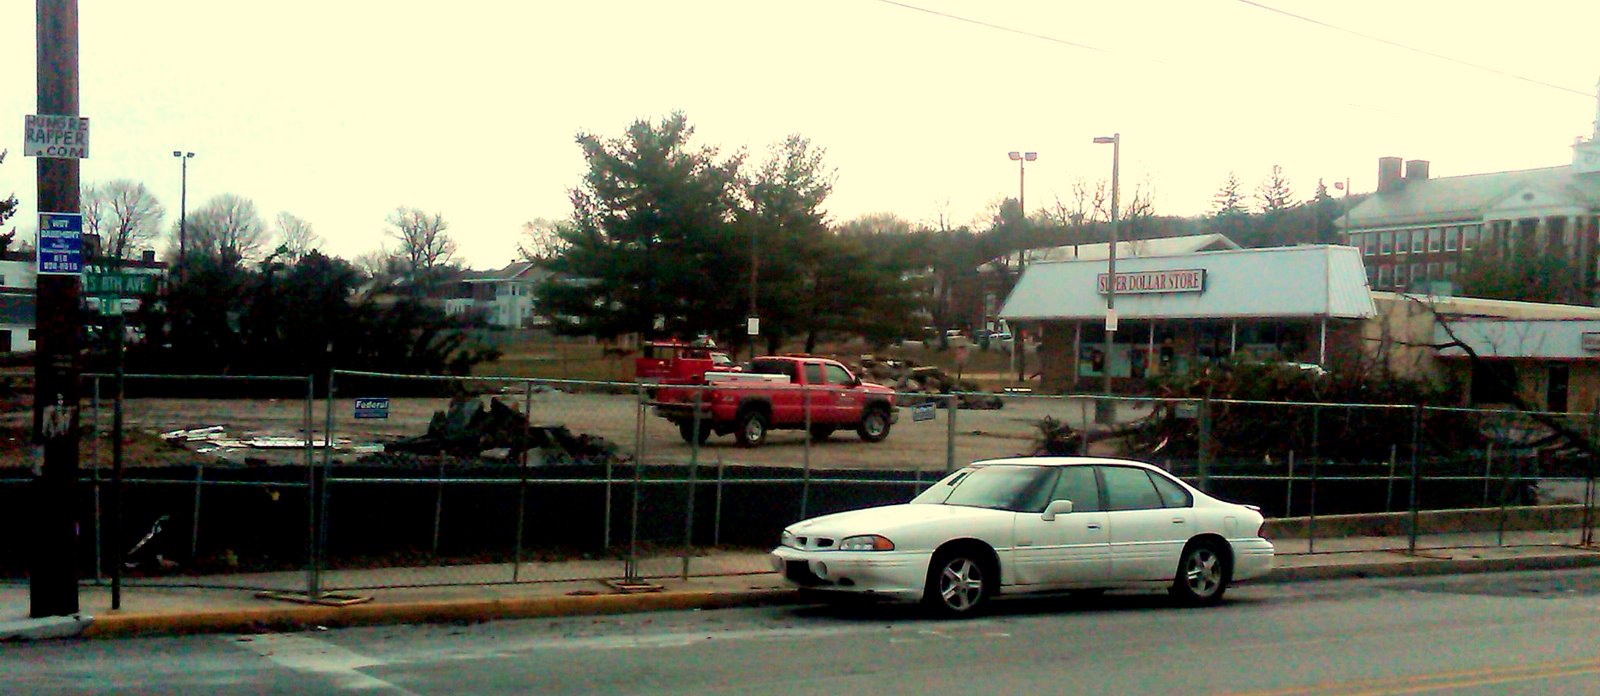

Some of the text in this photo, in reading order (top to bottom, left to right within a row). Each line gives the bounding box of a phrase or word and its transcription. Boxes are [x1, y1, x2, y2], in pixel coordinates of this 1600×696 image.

[26, 128, 88, 147] RAPPER
[126, 276, 147, 292] AVE
[1100, 272, 1199, 291] SUER DOLLAR STORE
[356, 400, 388, 409] Federal
